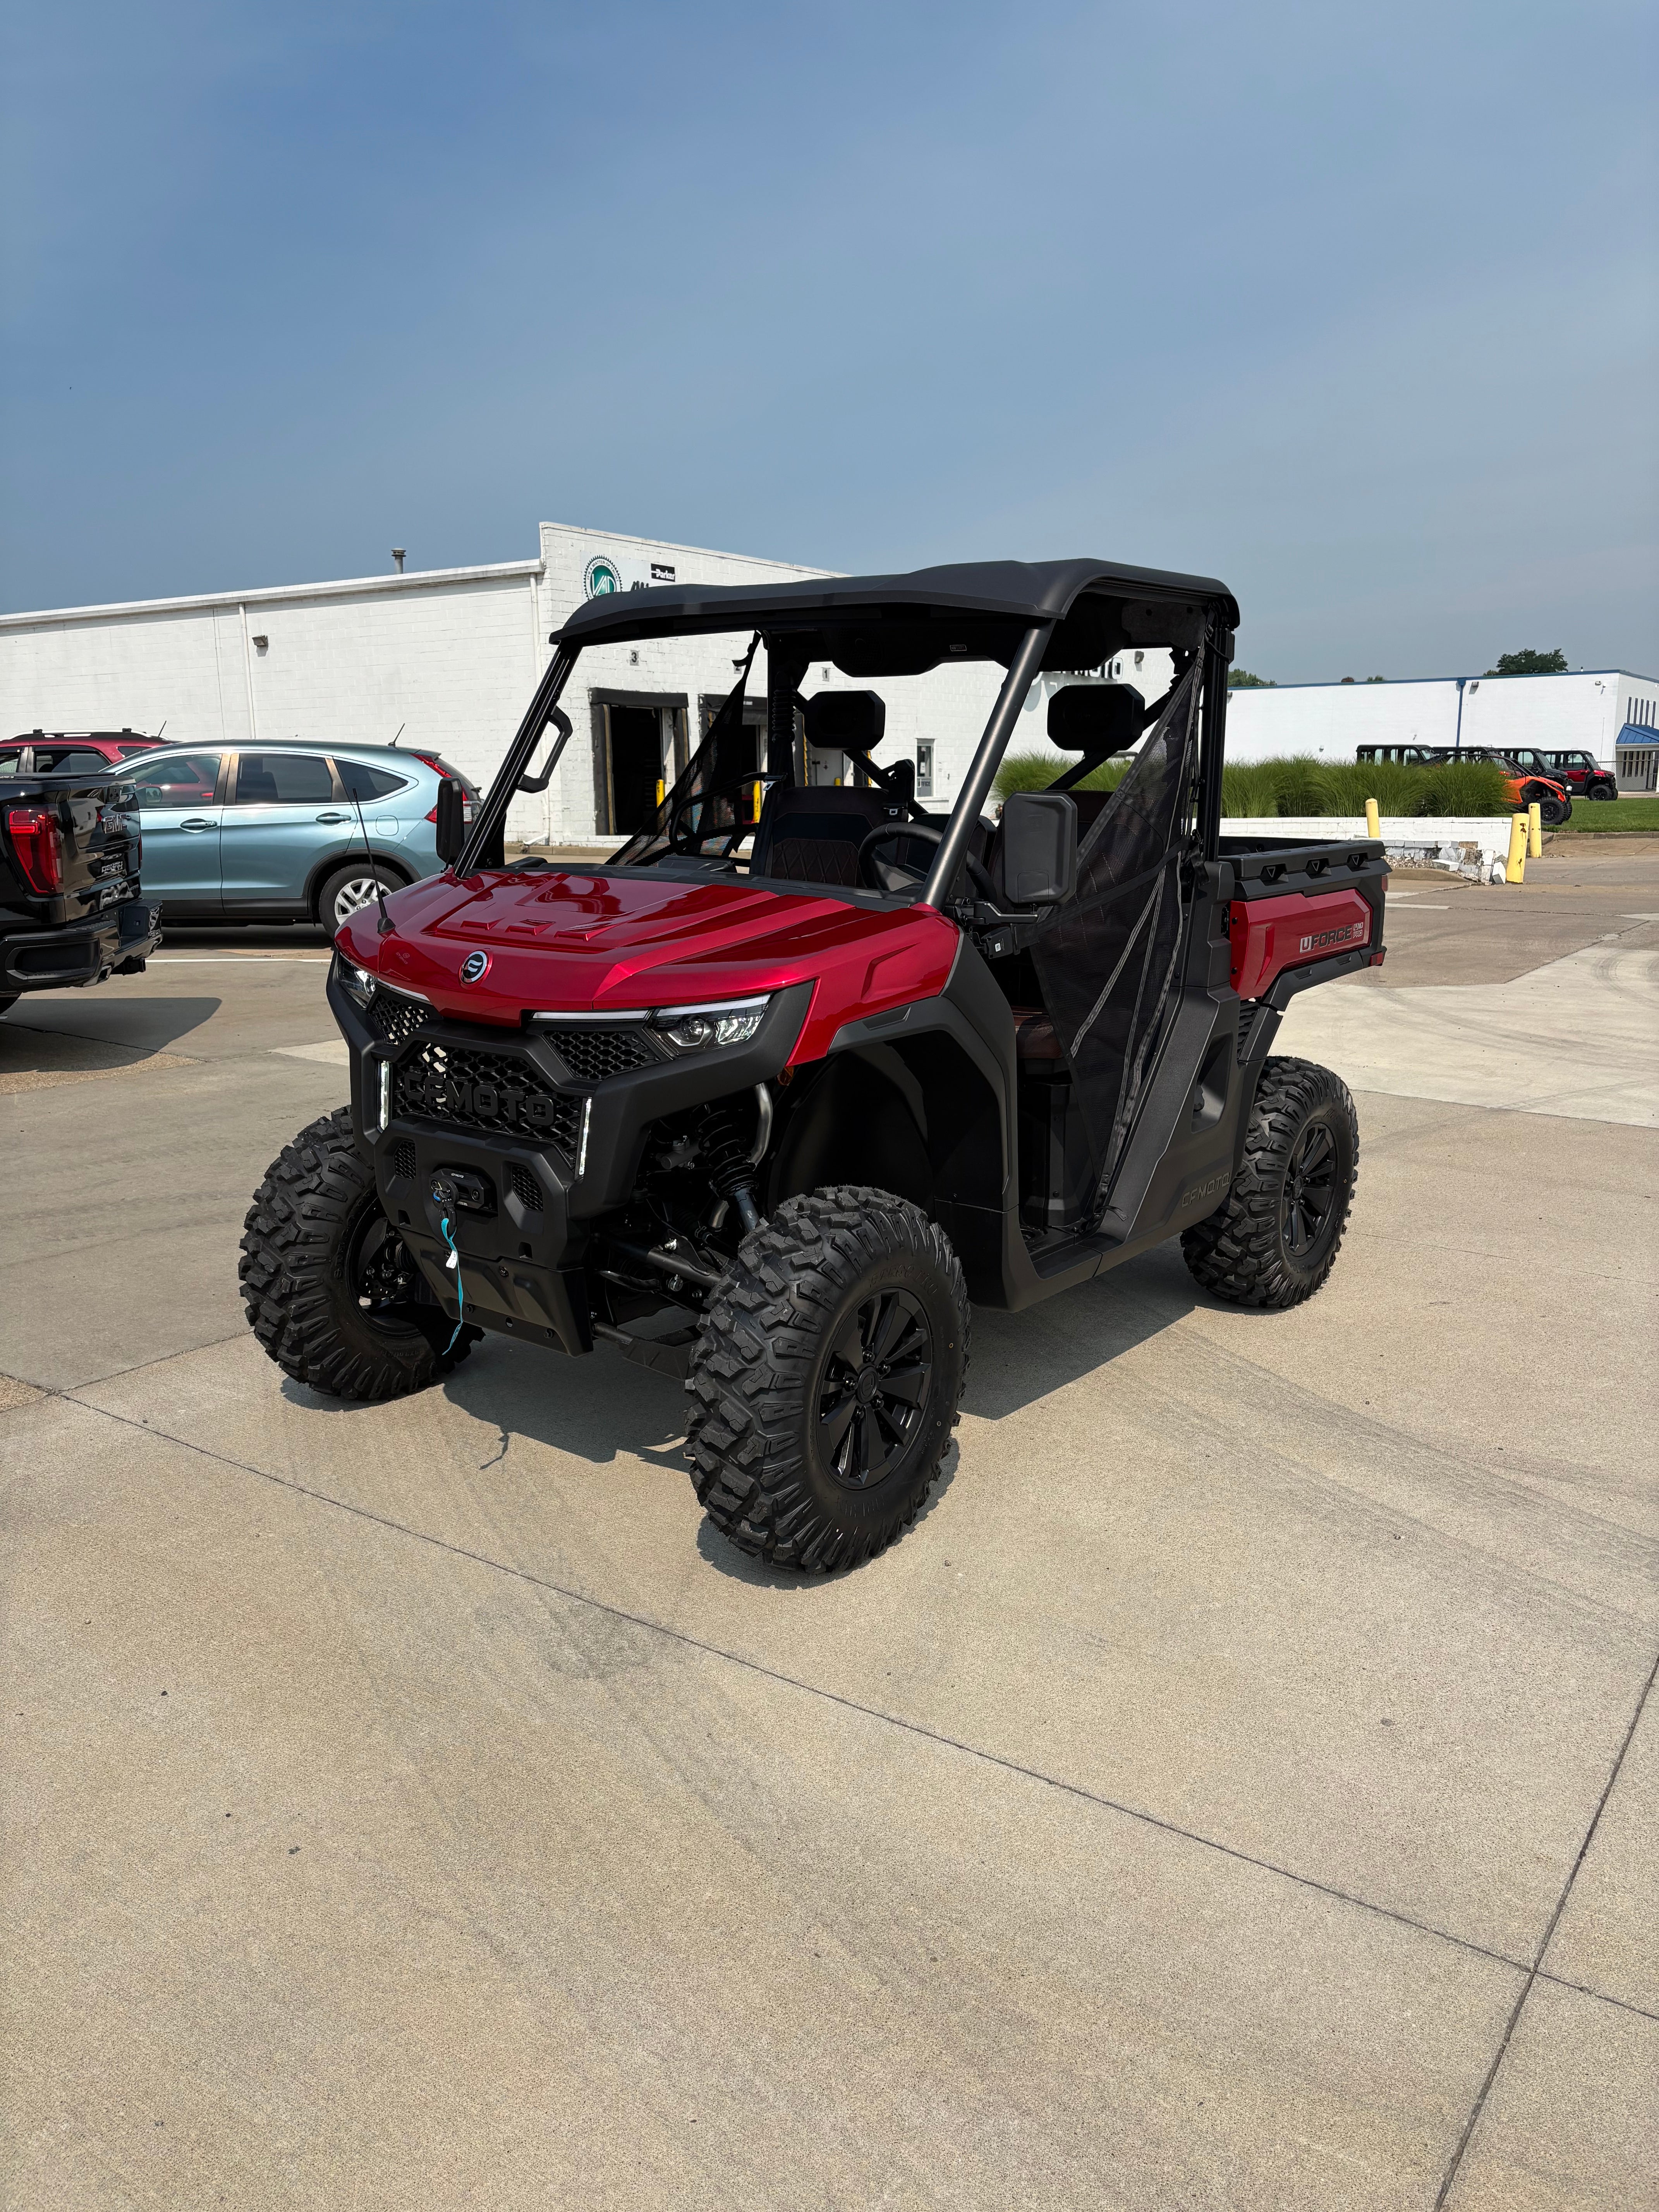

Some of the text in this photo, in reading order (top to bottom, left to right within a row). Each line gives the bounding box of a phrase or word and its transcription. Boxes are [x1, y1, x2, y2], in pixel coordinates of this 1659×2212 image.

[655, 568, 675, 580] Parker
[631, 652, 637, 663] 3
[824, 669, 828, 678] 1
[103, 813, 128, 834] GMC
[1300, 924, 1353, 954] UFORCE
[1353, 929, 1363, 938] PRO
[404, 1071, 554, 1126] CFMOTO
[1182, 1172, 1230, 1208] CFMOTO
